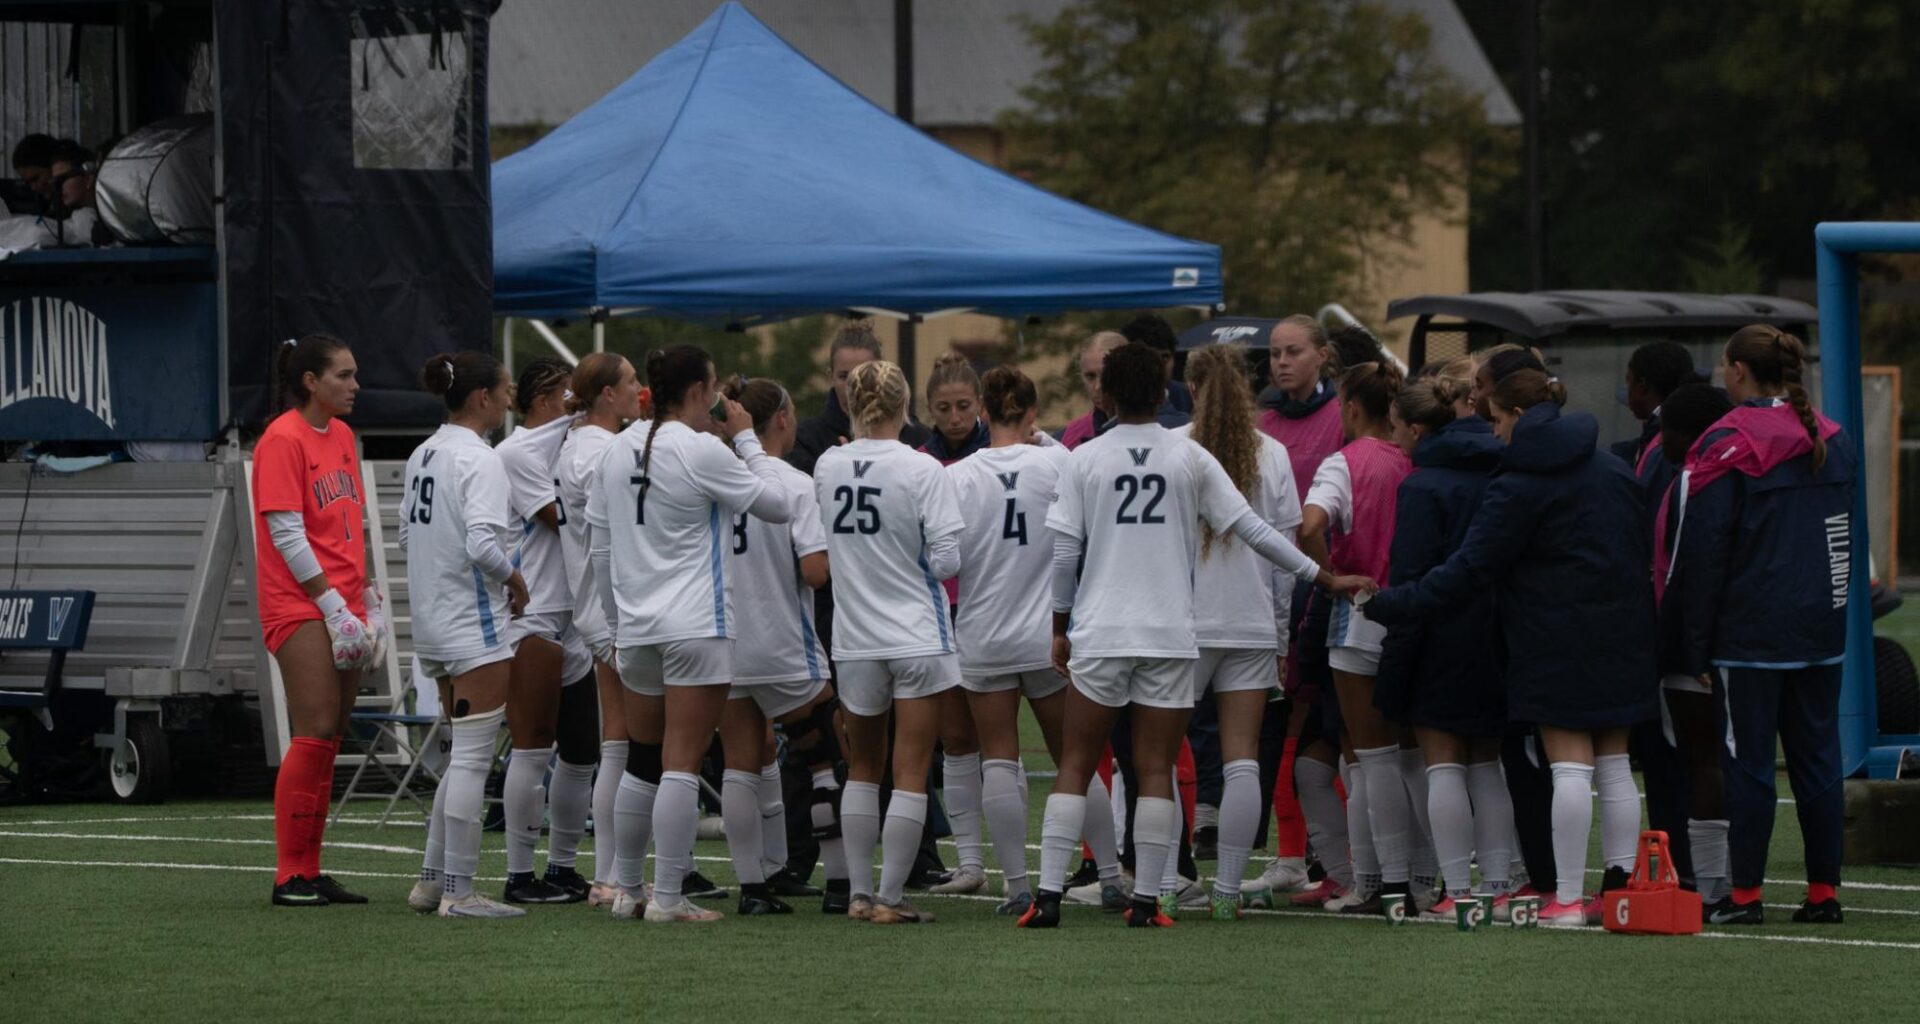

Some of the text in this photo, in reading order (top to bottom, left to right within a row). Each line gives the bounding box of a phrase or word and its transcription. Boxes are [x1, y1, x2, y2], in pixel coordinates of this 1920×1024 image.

[410, 475, 434, 525] 29
[630, 476, 651, 525] 7
[833, 486, 882, 535] 25
[1003, 499, 1028, 545] 4
[1115, 474, 1166, 524] 22
[1390, 901, 1405, 922] G
[1511, 904, 1527, 925] G
[1616, 898, 1629, 926] G
